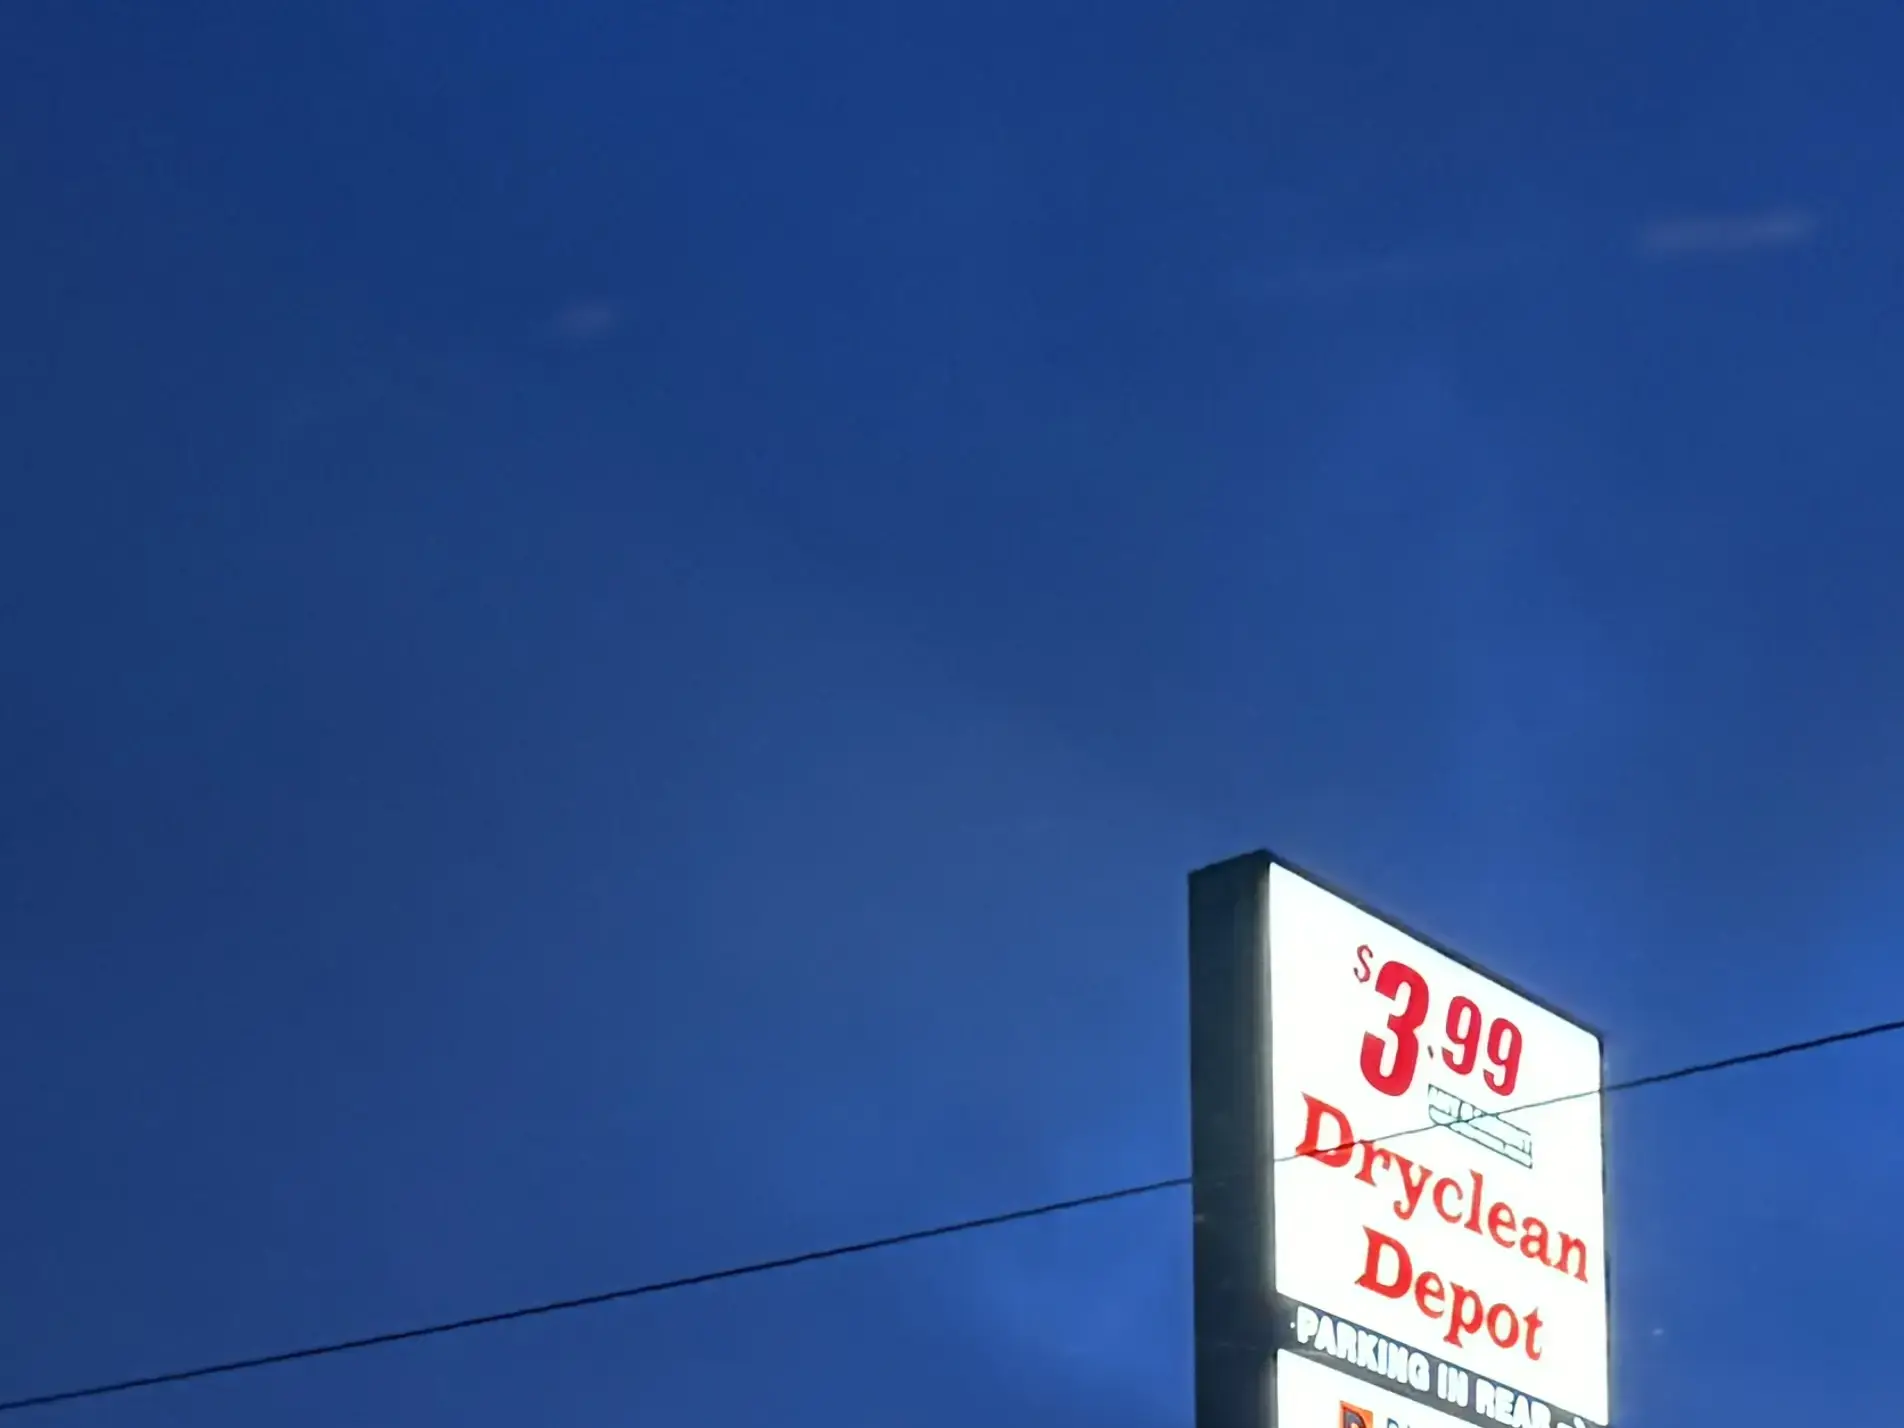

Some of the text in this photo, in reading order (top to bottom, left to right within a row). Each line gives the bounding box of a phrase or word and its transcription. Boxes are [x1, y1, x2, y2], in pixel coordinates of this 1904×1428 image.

[1295, 1091, 1589, 1284] Dryclean
[1296, 1305, 1431, 1393] PARKING
[1437, 1362, 1470, 1408] IN
[1354, 1225, 1544, 1361] Depot
